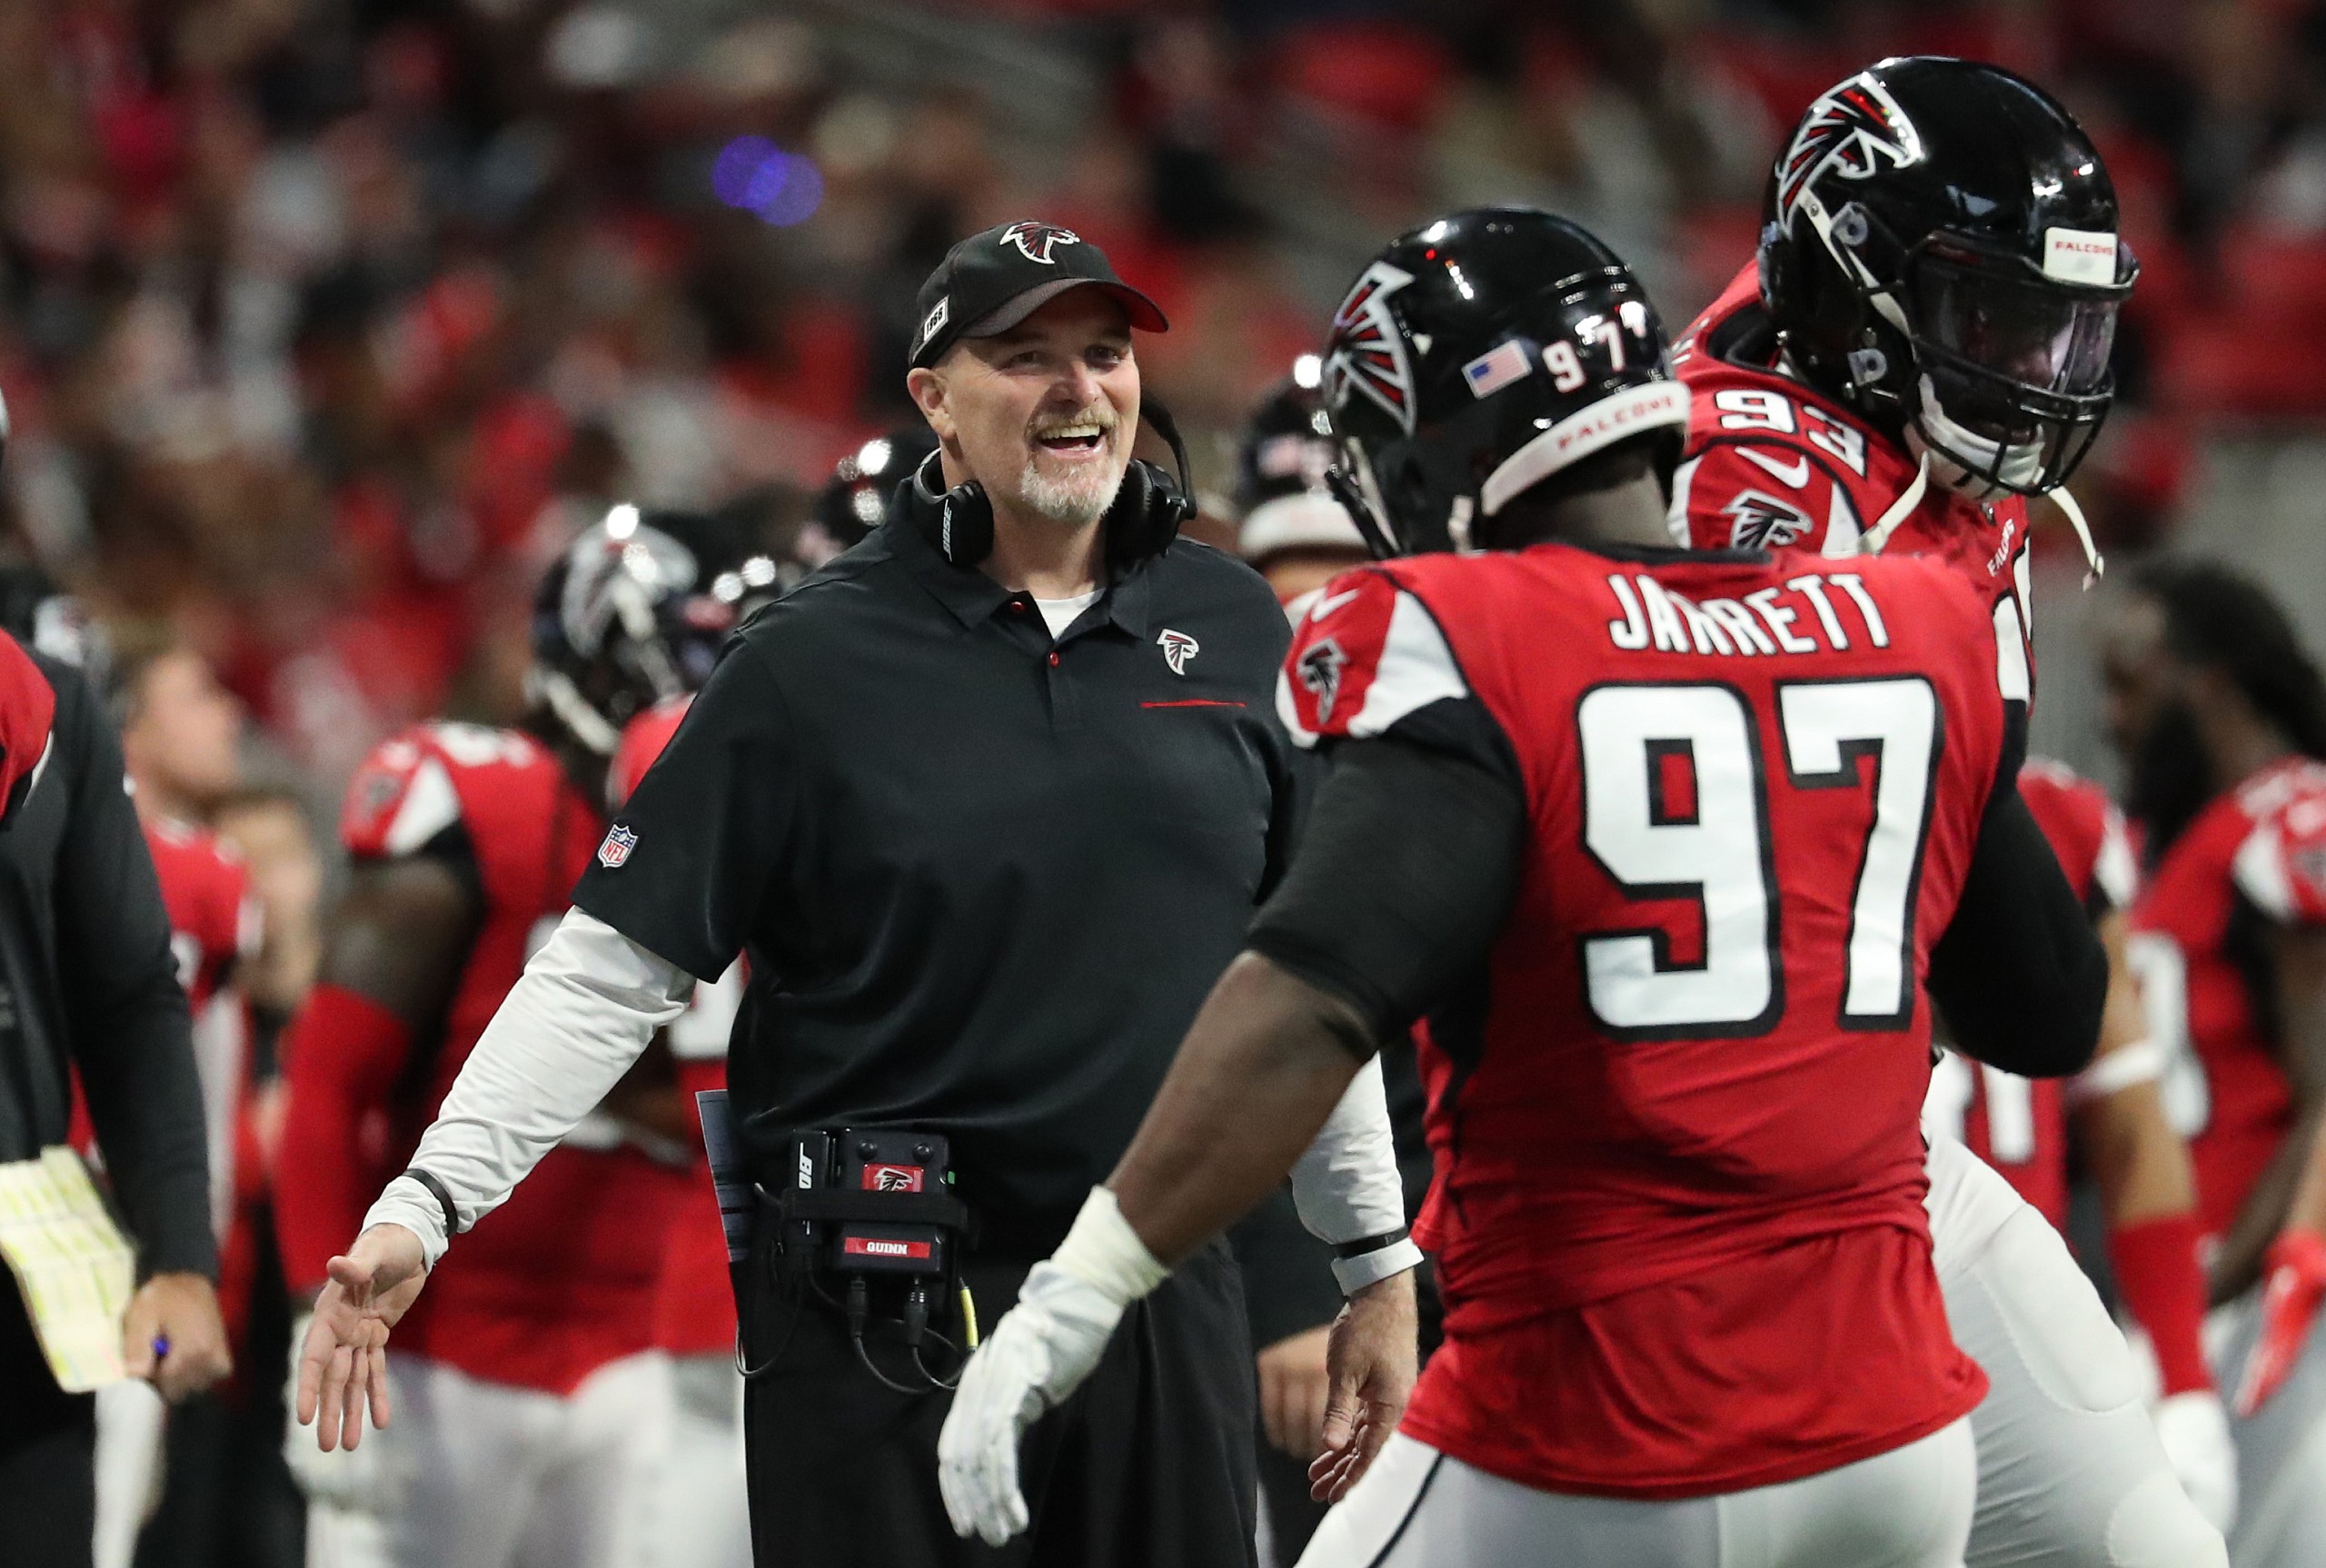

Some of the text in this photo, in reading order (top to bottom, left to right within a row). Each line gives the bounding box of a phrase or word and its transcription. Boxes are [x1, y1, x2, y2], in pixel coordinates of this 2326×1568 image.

[1542, 321, 1625, 393] 97
[1715, 389, 1867, 479] 93
[943, 499, 952, 561] BOSE
[1608, 573, 1890, 656] JARRETT
[1576, 676, 1941, 1038] 97
[867, 1241, 908, 1255] QUINN
